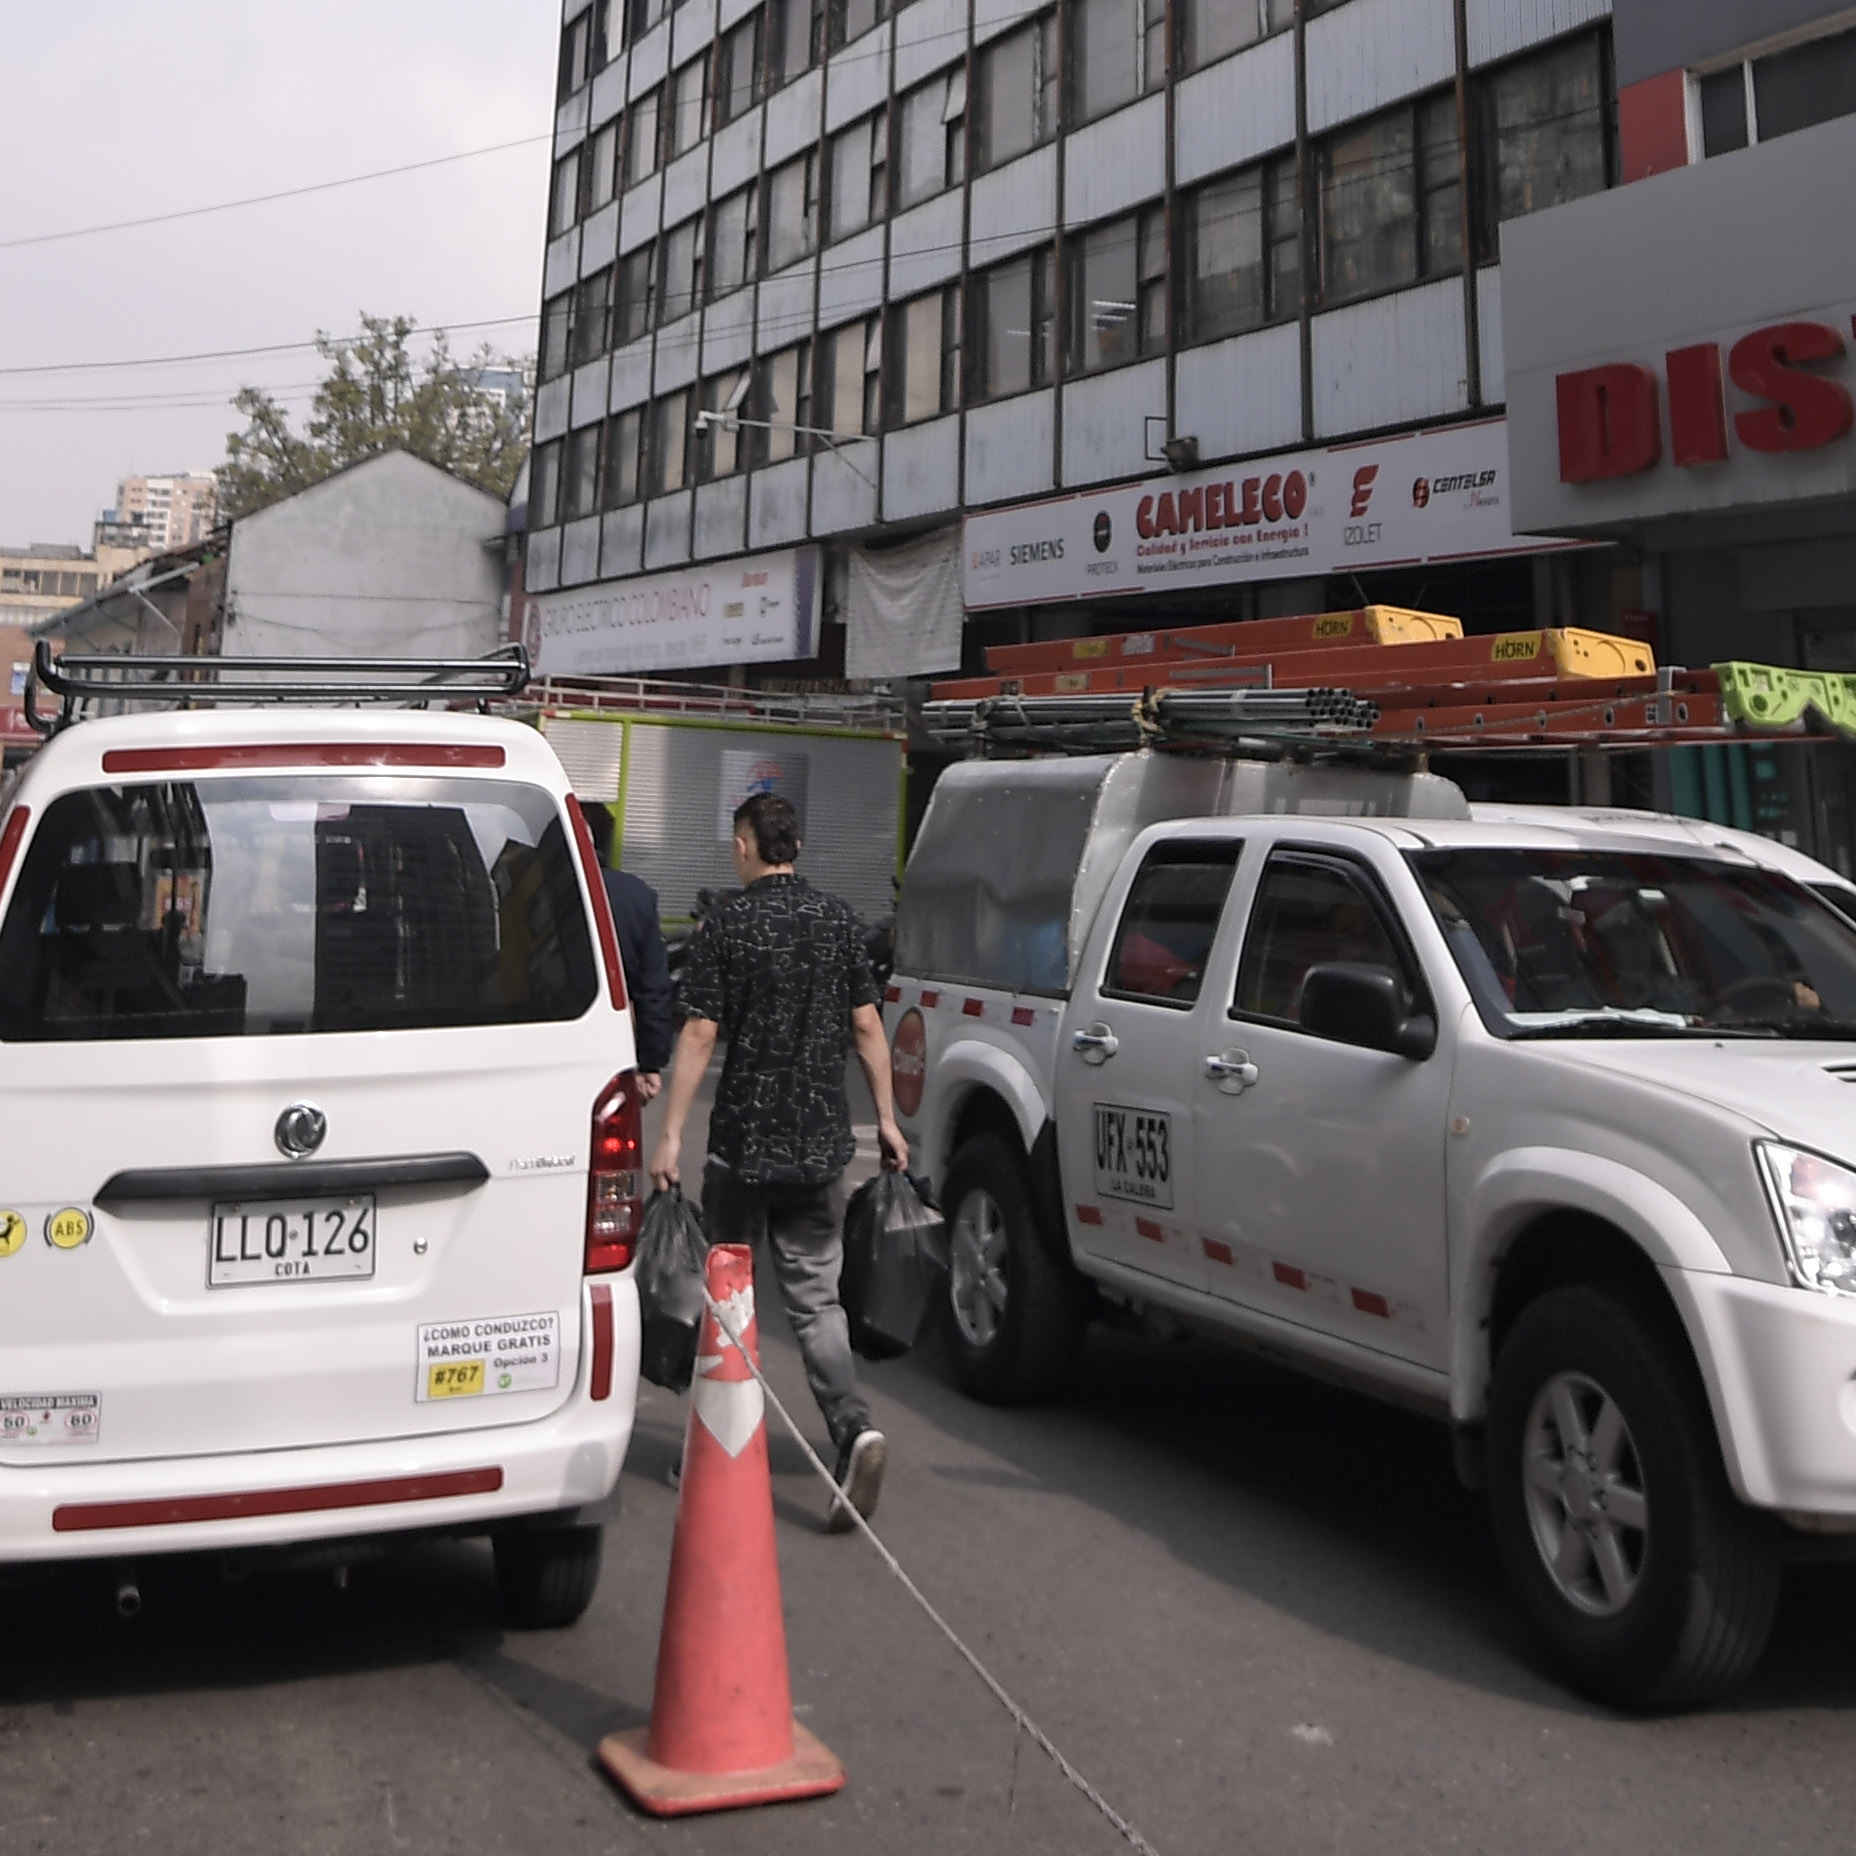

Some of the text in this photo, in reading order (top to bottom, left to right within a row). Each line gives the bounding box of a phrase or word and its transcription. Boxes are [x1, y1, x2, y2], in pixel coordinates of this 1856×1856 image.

[1433, 469, 1496, 494] CENTELSA
[1010, 539, 1065, 565] SIEMENS
[55, 1220, 83, 1237] ABS
[275, 1261, 311, 1276] COTA
[424, 1317, 554, 1342] ¿COMO CONDUZCO?
[428, 1334, 551, 1357] MARQUE GRATIS
[435, 1366, 479, 1385] #767
